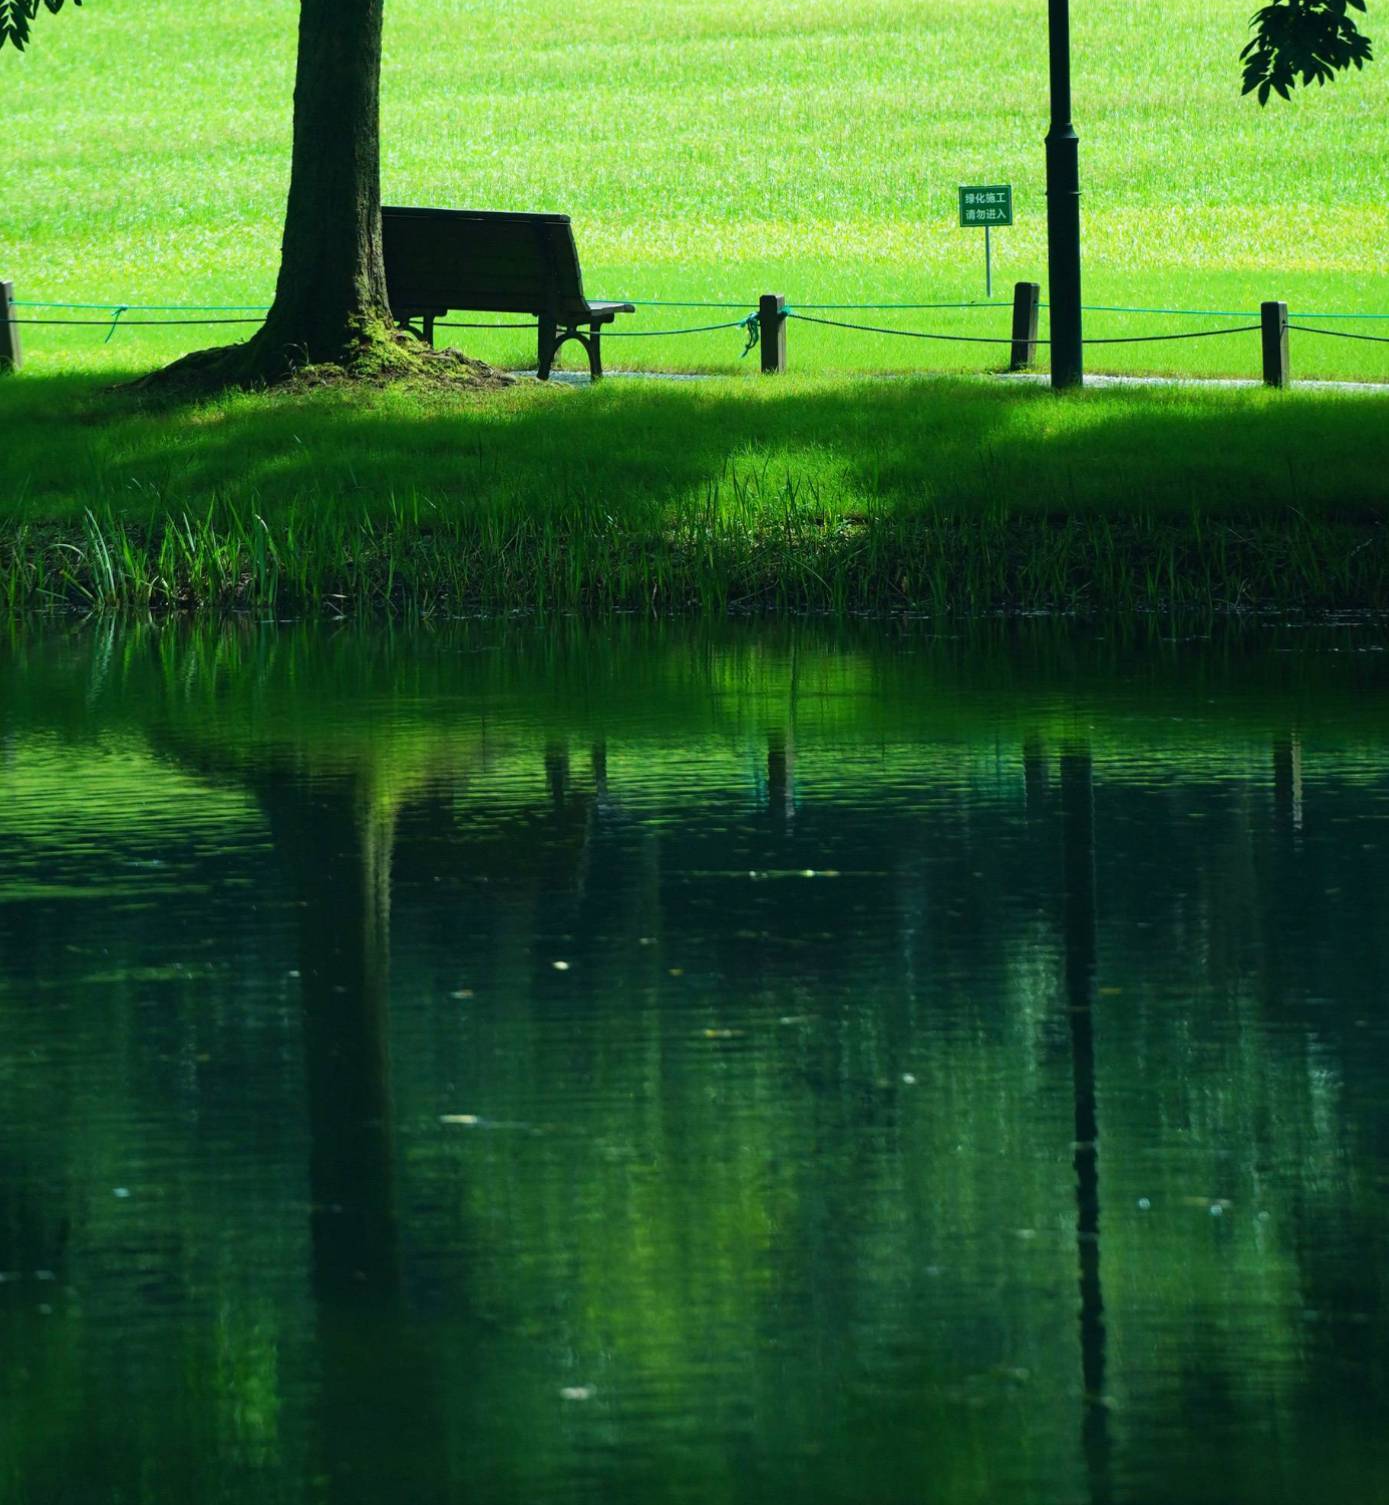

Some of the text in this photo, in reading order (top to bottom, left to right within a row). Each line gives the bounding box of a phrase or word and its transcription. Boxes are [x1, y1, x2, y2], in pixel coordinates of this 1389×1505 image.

[965, 192, 1006, 204] 绿化施工
[965, 208, 1007, 220] 请勿进入
